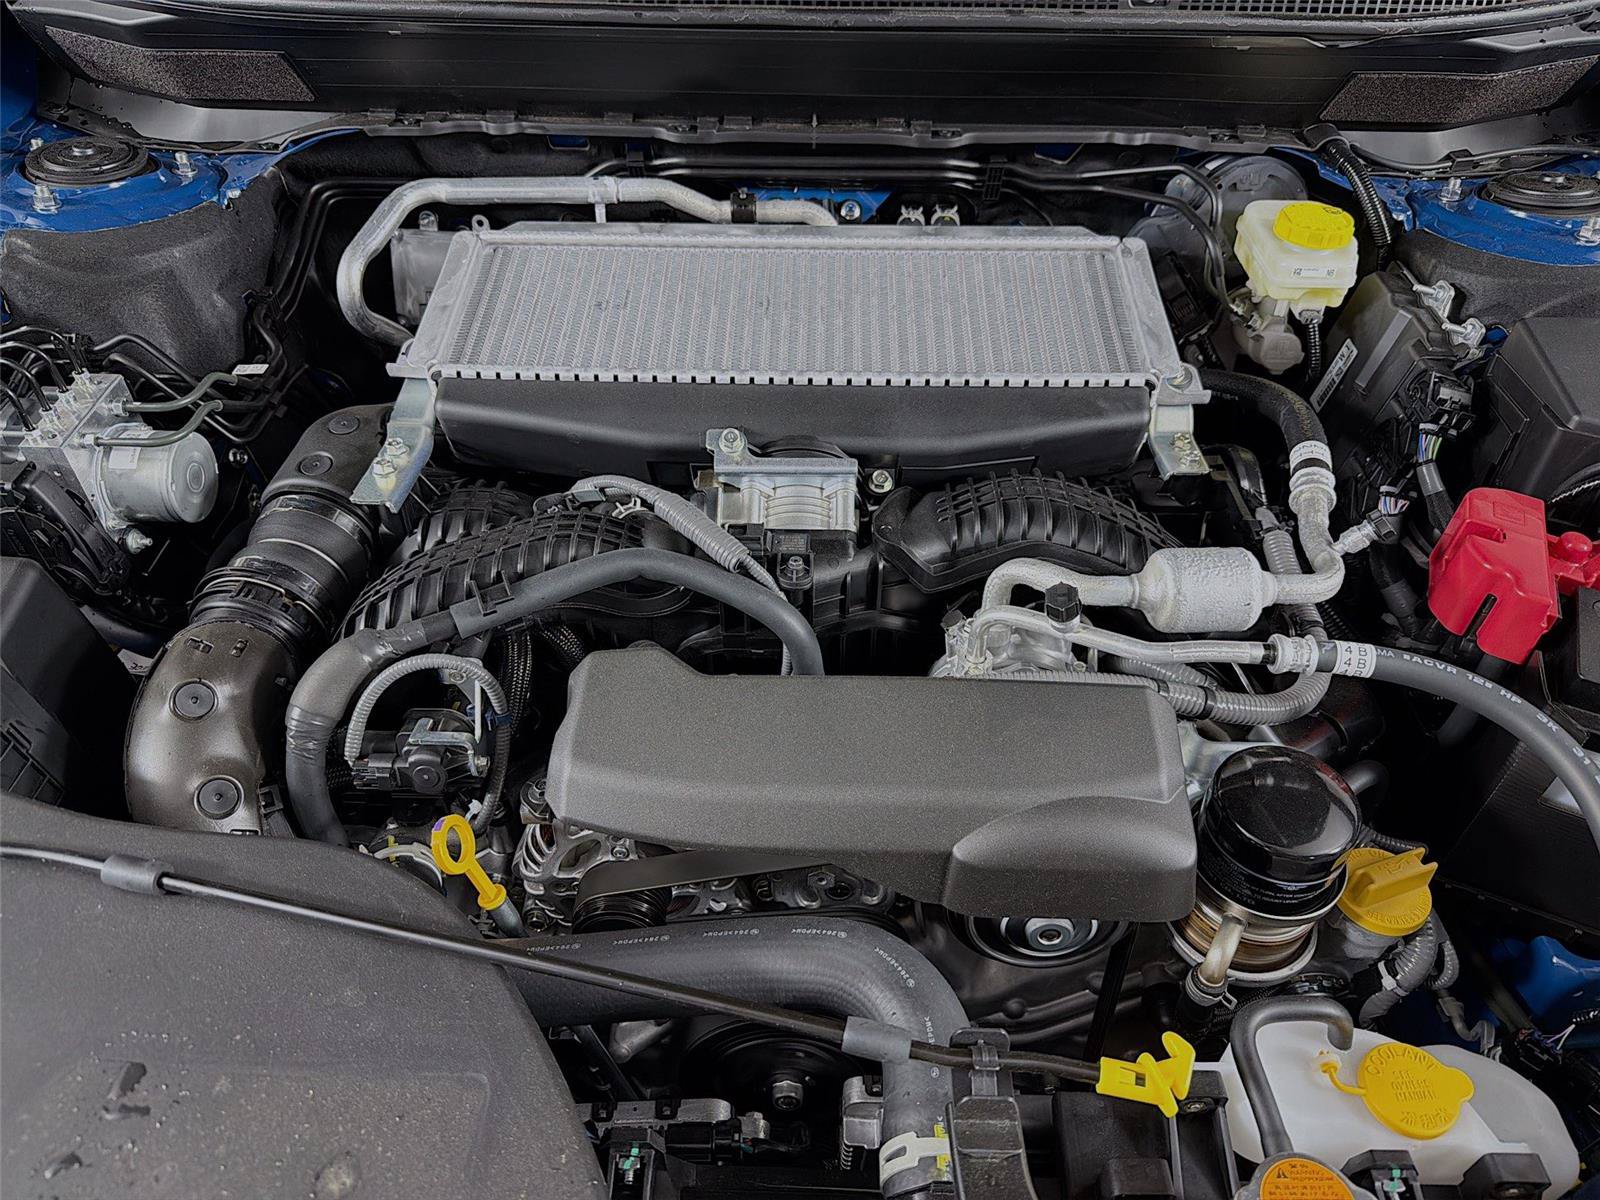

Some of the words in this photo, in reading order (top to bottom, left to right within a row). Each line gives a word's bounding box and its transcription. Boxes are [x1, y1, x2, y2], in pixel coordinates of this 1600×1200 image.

[1344, 645, 1353, 655] 4
[1343, 657, 1352, 667] 4
[1366, 1046, 1439, 1076] COOLANT
